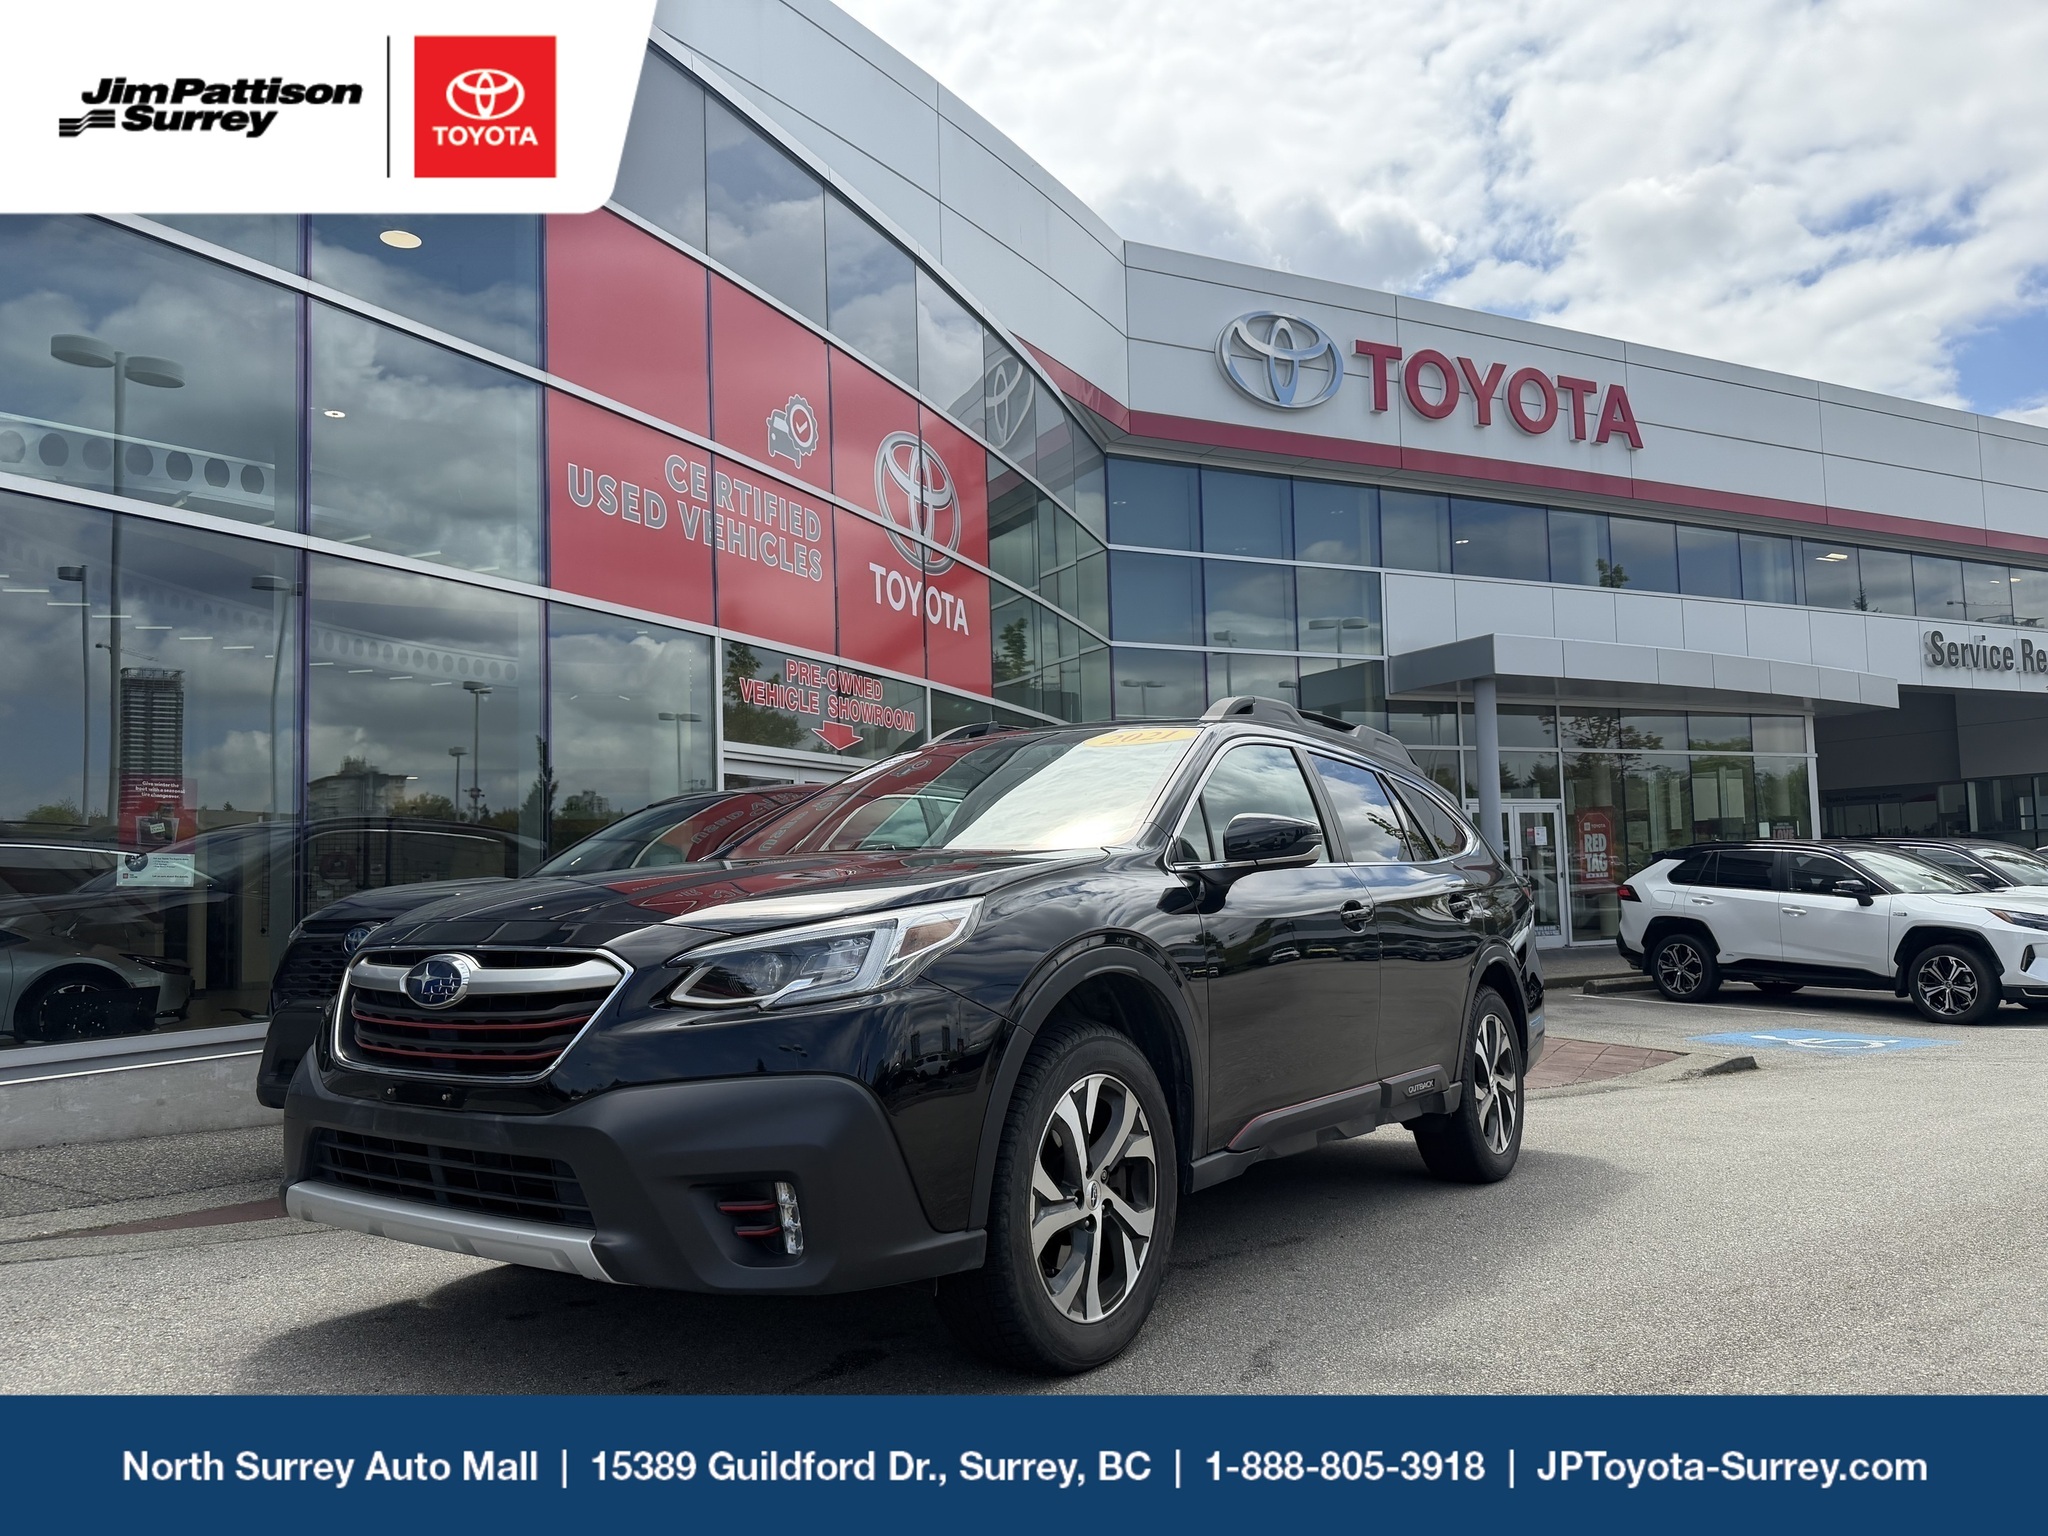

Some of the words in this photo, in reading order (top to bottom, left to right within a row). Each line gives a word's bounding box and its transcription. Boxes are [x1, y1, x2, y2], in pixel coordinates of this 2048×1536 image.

[1351, 339, 1644, 451] TOYOTA
[664, 454, 822, 543] CERTIFIED
[567, 463, 668, 530] USED
[677, 500, 823, 582] VEHICLES
[868, 561, 970, 636] TOYOTA
[1923, 630, 2015, 671] Service
[786, 658, 883, 701] PRE-OWNED
[739, 677, 820, 715] VEHICLE
[827, 694, 916, 733] SHOWROOM
[1101, 730, 1180, 745] 2021
[1584, 833, 1607, 853] RED
[1584, 852, 1608, 872] TAG
[1408, 1079, 1434, 1094] OUTBACK
